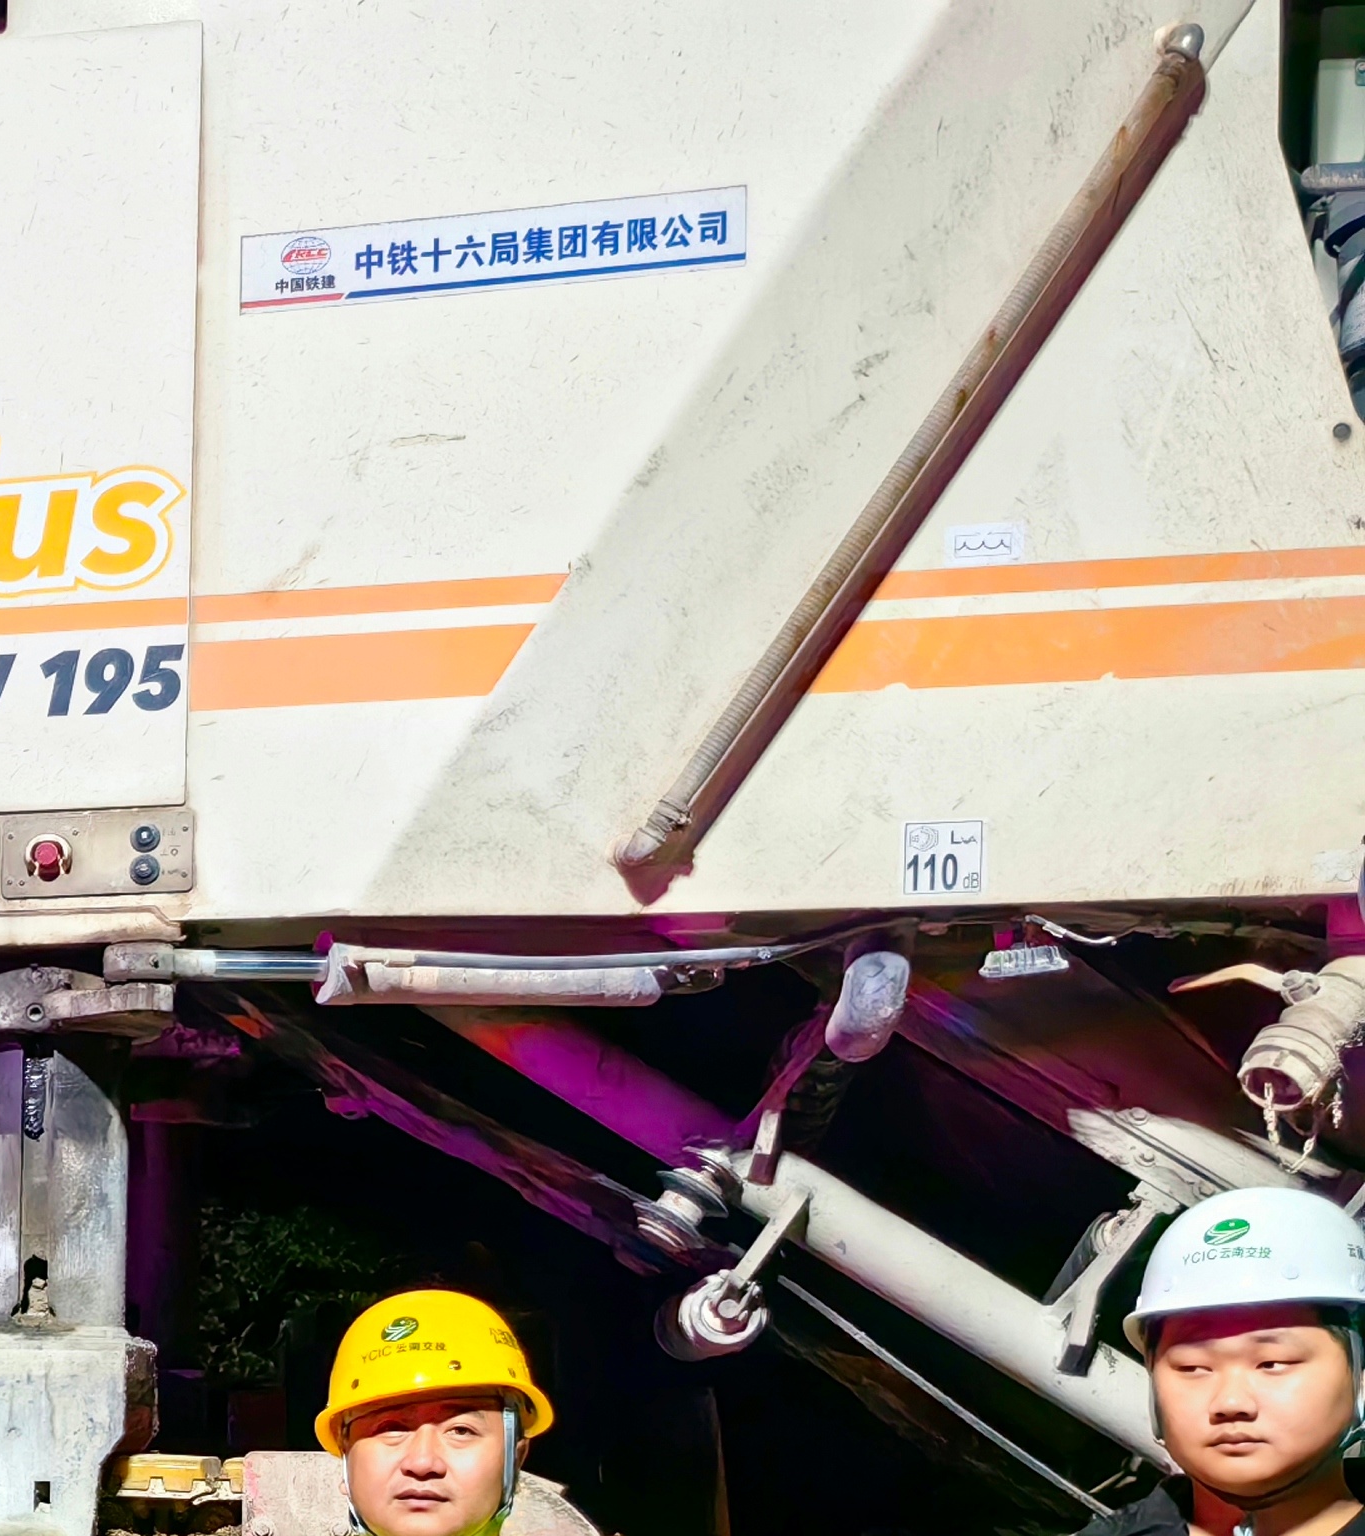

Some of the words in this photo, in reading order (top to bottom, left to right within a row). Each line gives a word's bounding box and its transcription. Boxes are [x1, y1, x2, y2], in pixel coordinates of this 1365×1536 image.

[354, 210, 729, 279] 中铁十六局集团有限公司
[275, 274, 337, 294] 中国铁建
[39, 643, 186, 718] 195
[906, 852, 959, 892] 110
[1182, 1249, 1218, 1266] YCIC
[361, 1345, 392, 1364] YCIC
